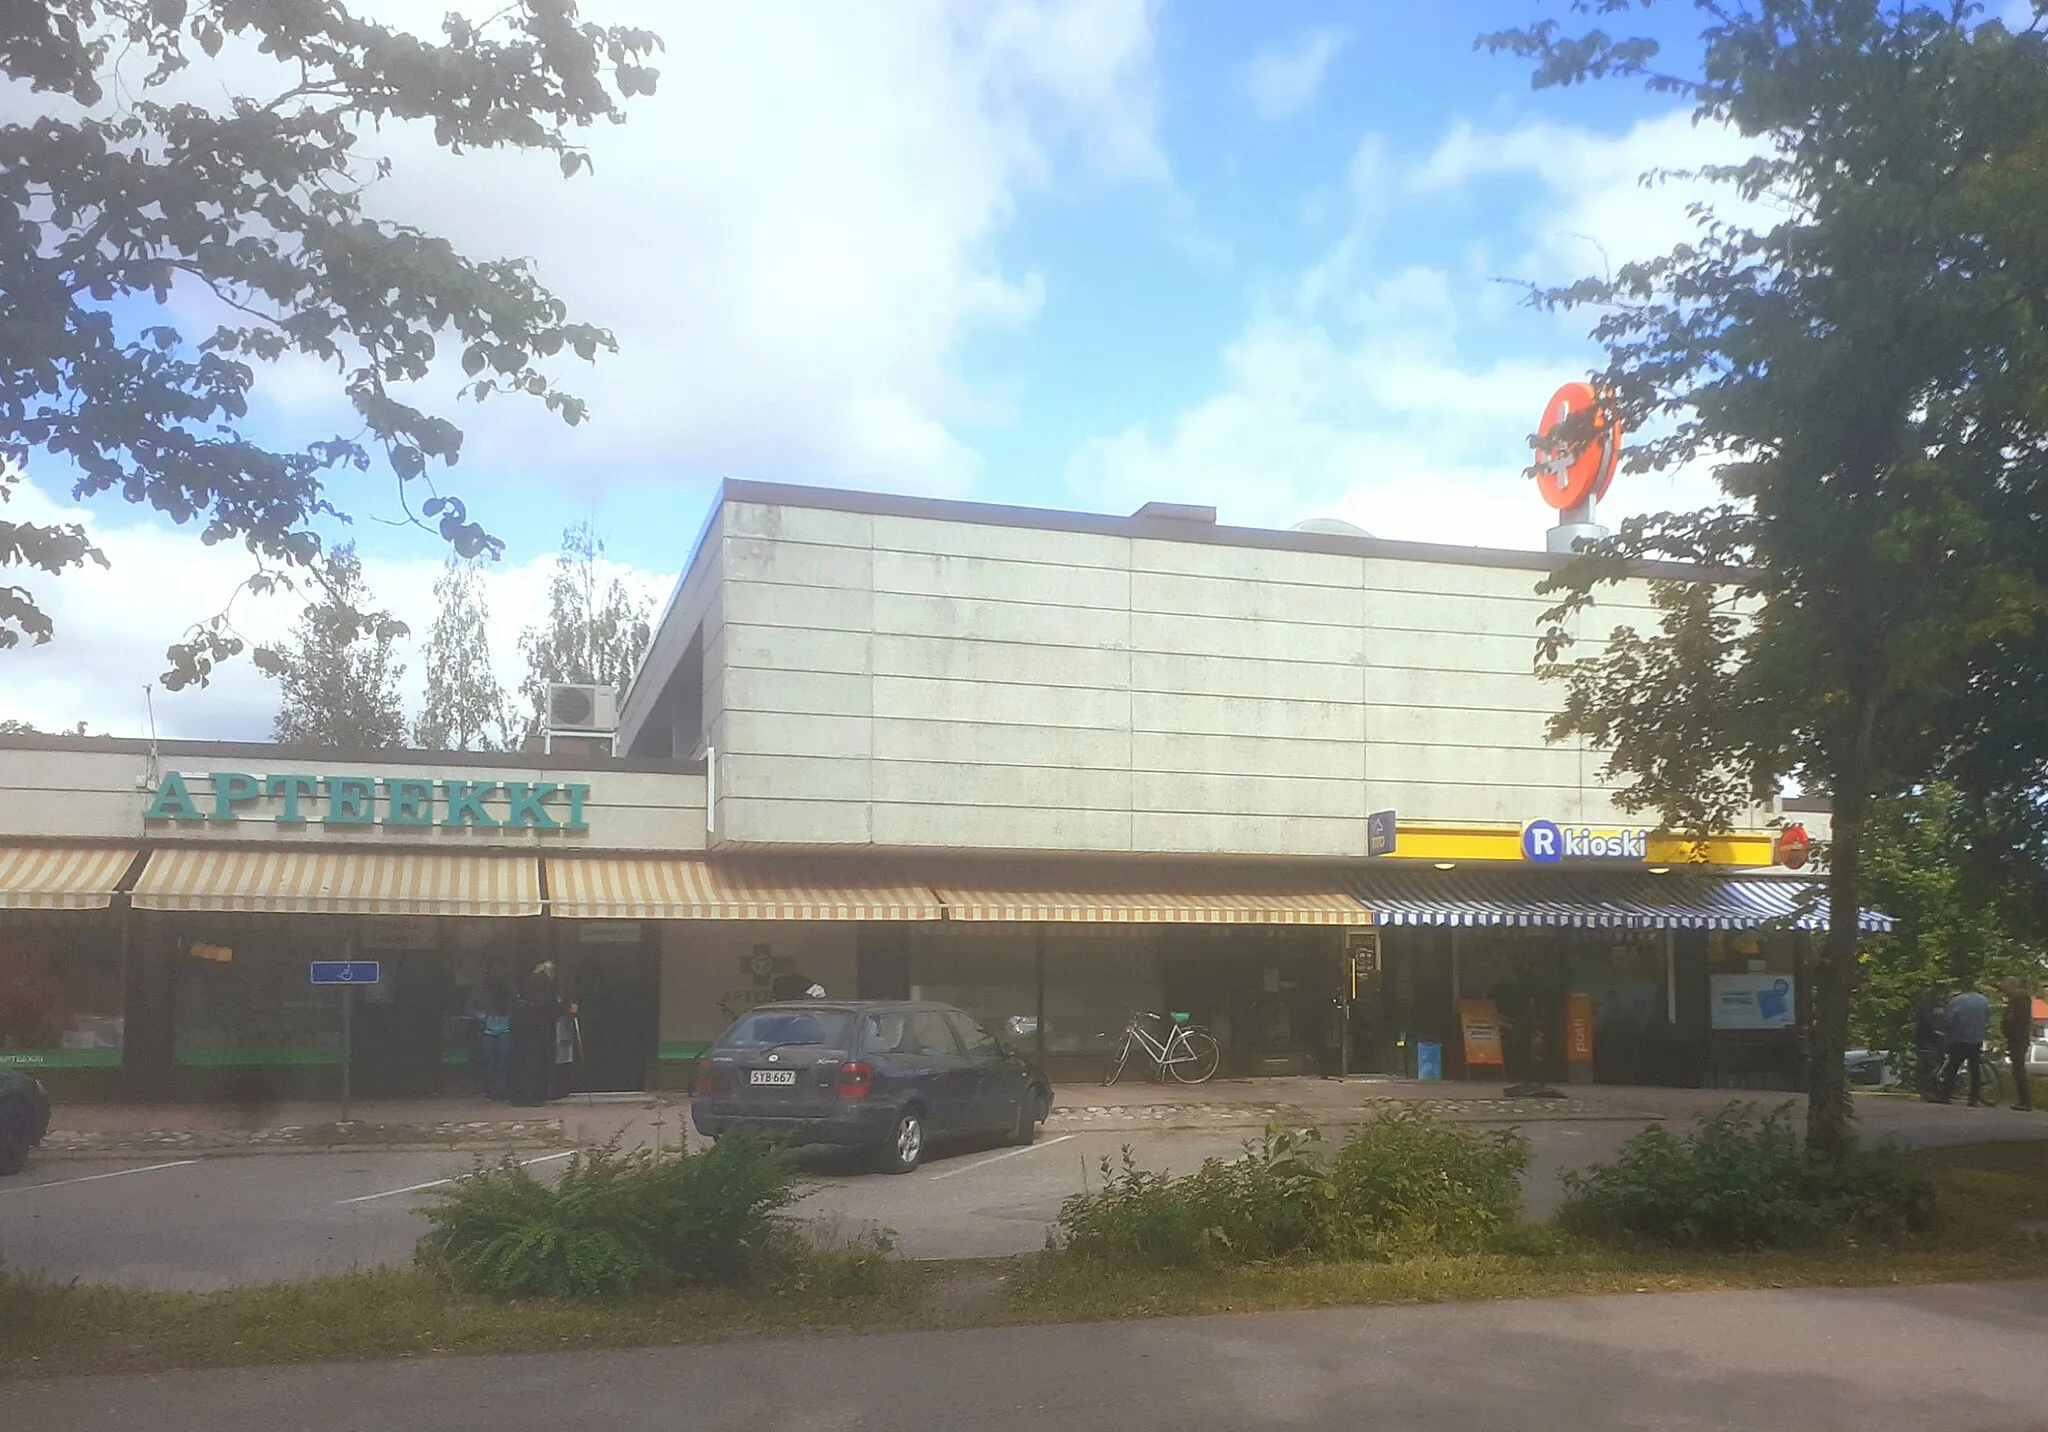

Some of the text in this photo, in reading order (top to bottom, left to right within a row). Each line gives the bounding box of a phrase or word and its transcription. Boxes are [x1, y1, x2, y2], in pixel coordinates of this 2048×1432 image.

[143, 770, 588, 830] APTEEKKI
[1532, 828, 1646, 857] R kioski
